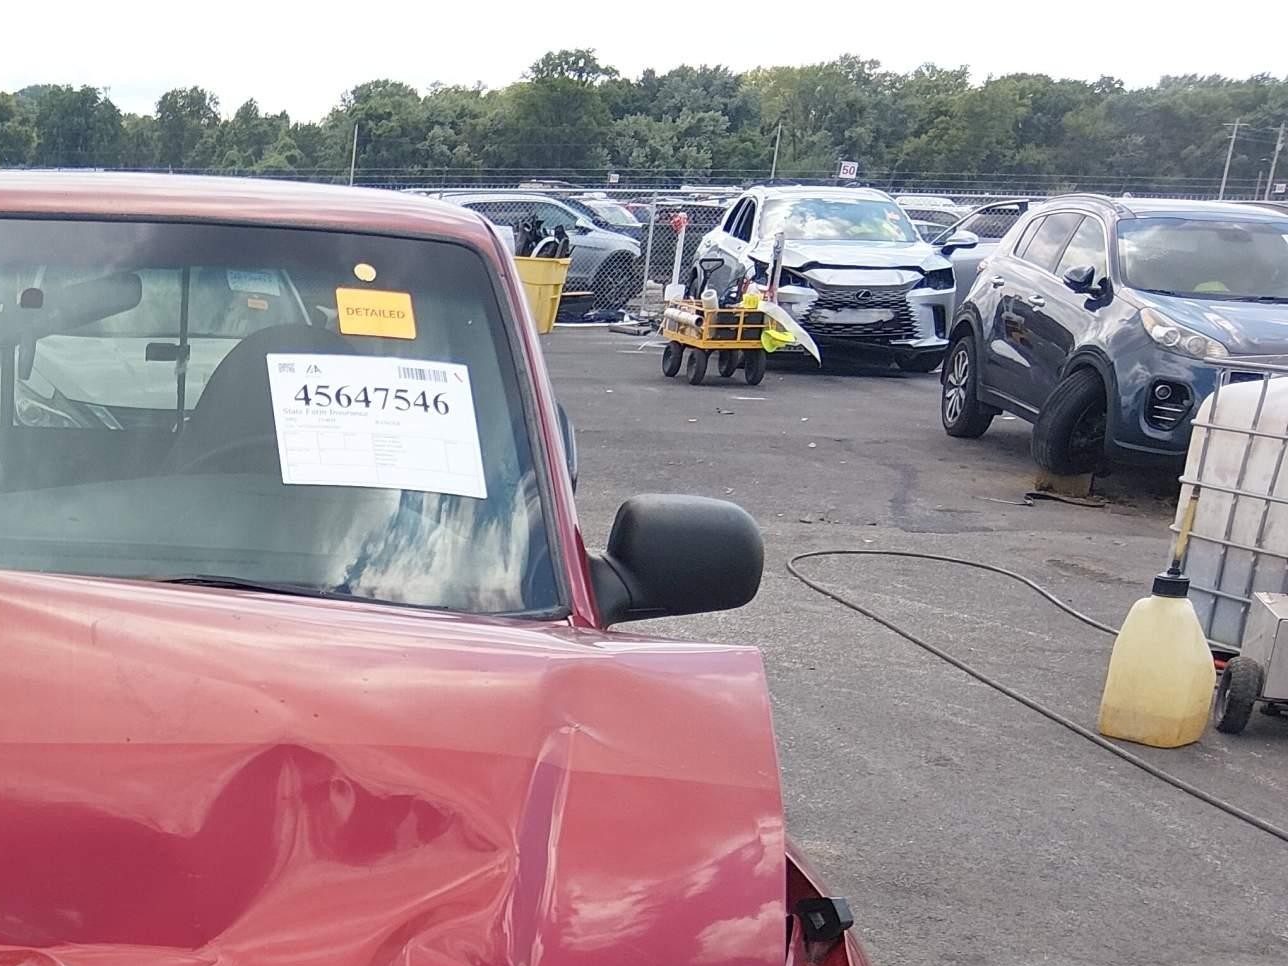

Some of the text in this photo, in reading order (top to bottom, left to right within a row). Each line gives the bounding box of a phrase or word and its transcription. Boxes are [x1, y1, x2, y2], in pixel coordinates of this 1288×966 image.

[842, 165, 856, 175] 50
[346, 307, 406, 319] DETAILED
[294, 384, 450, 415] 45647546
